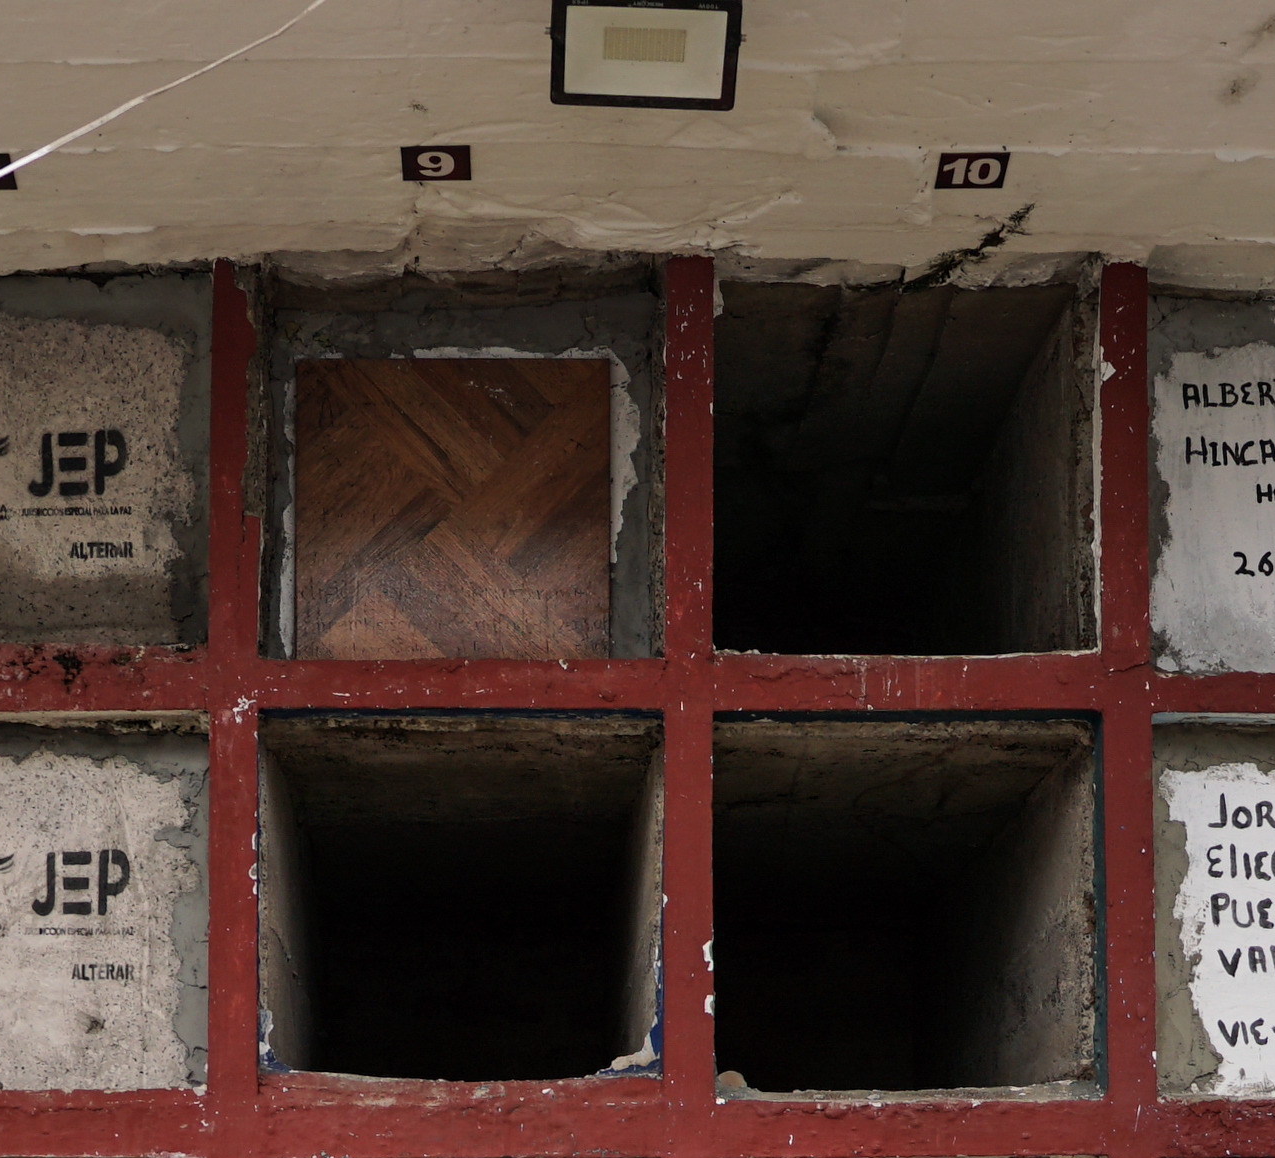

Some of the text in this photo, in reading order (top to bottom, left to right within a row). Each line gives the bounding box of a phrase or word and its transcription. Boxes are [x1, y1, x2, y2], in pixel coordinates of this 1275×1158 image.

[416, 151, 456, 178] 9
[941, 158, 1003, 185] 10
[27, 429, 126, 497] JEP
[31, 849, 130, 916] JEP
[71, 963, 135, 980] ALTERAR
